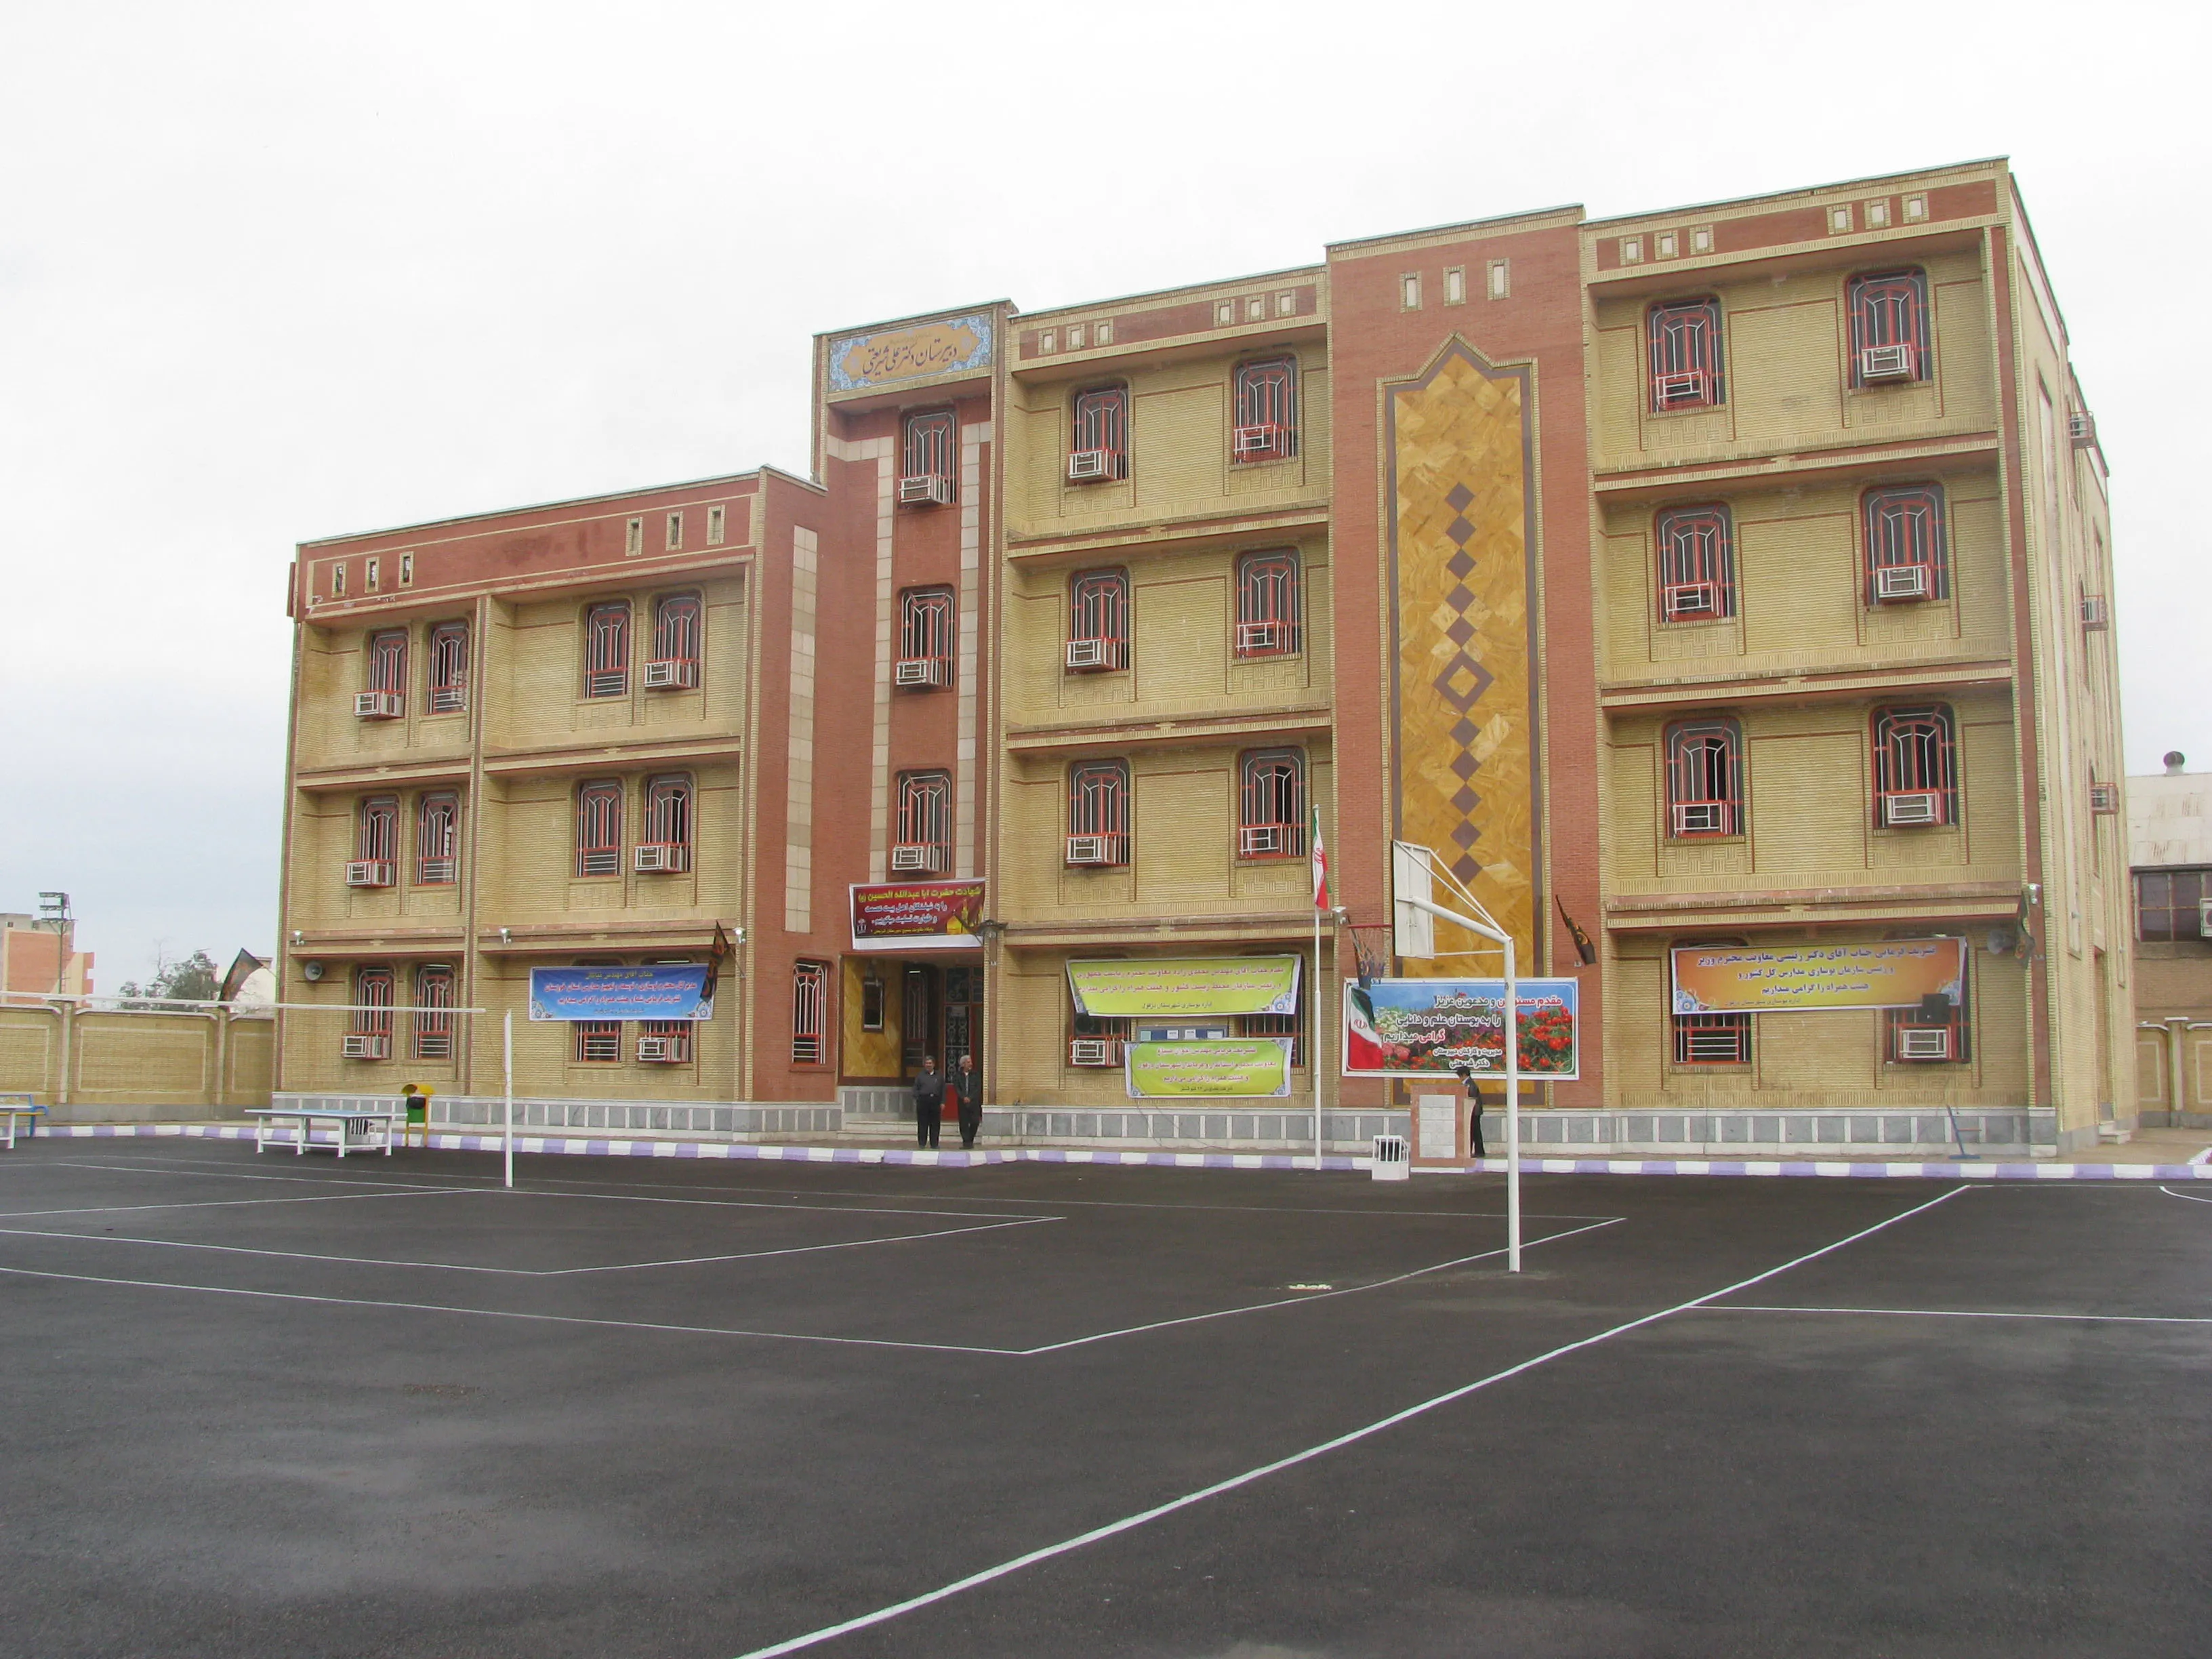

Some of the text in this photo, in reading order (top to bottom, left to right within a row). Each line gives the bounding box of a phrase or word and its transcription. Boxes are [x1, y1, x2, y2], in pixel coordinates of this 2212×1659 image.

[863, 338, 957, 376] دبیرستان دکتر علی شریعتی
[867, 890, 893, 901] الحسین
[895, 890, 920, 900] عبدالله
[931, 888, 954, 899] حضرت
[955, 886, 981, 897] شهادت
[1805, 950, 1824, 962] دکتر
[1826, 948, 1847, 960] آقای
[1850, 947, 1872, 957] جناب
[1908, 945, 1936, 958] تشریف
[1697, 957, 1715, 966] وزیر
[1745, 951, 1774, 964] معاونت
[1745, 968, 1763, 979] کشور
[1765, 968, 1776, 978] کل
[1778, 968, 1805, 978] مدارس
[1809, 966, 1835, 977] نوسازی
[1435, 995, 1562, 1008] مقدم مسئن و مدعوین عزیز
[1396, 1014, 1501, 1027] را به بوستان علم و دانایی
[1384, 1029, 1446, 1043] گرامی میداریم
[1450, 1059, 1490, 1068] دکتر شریعتی
